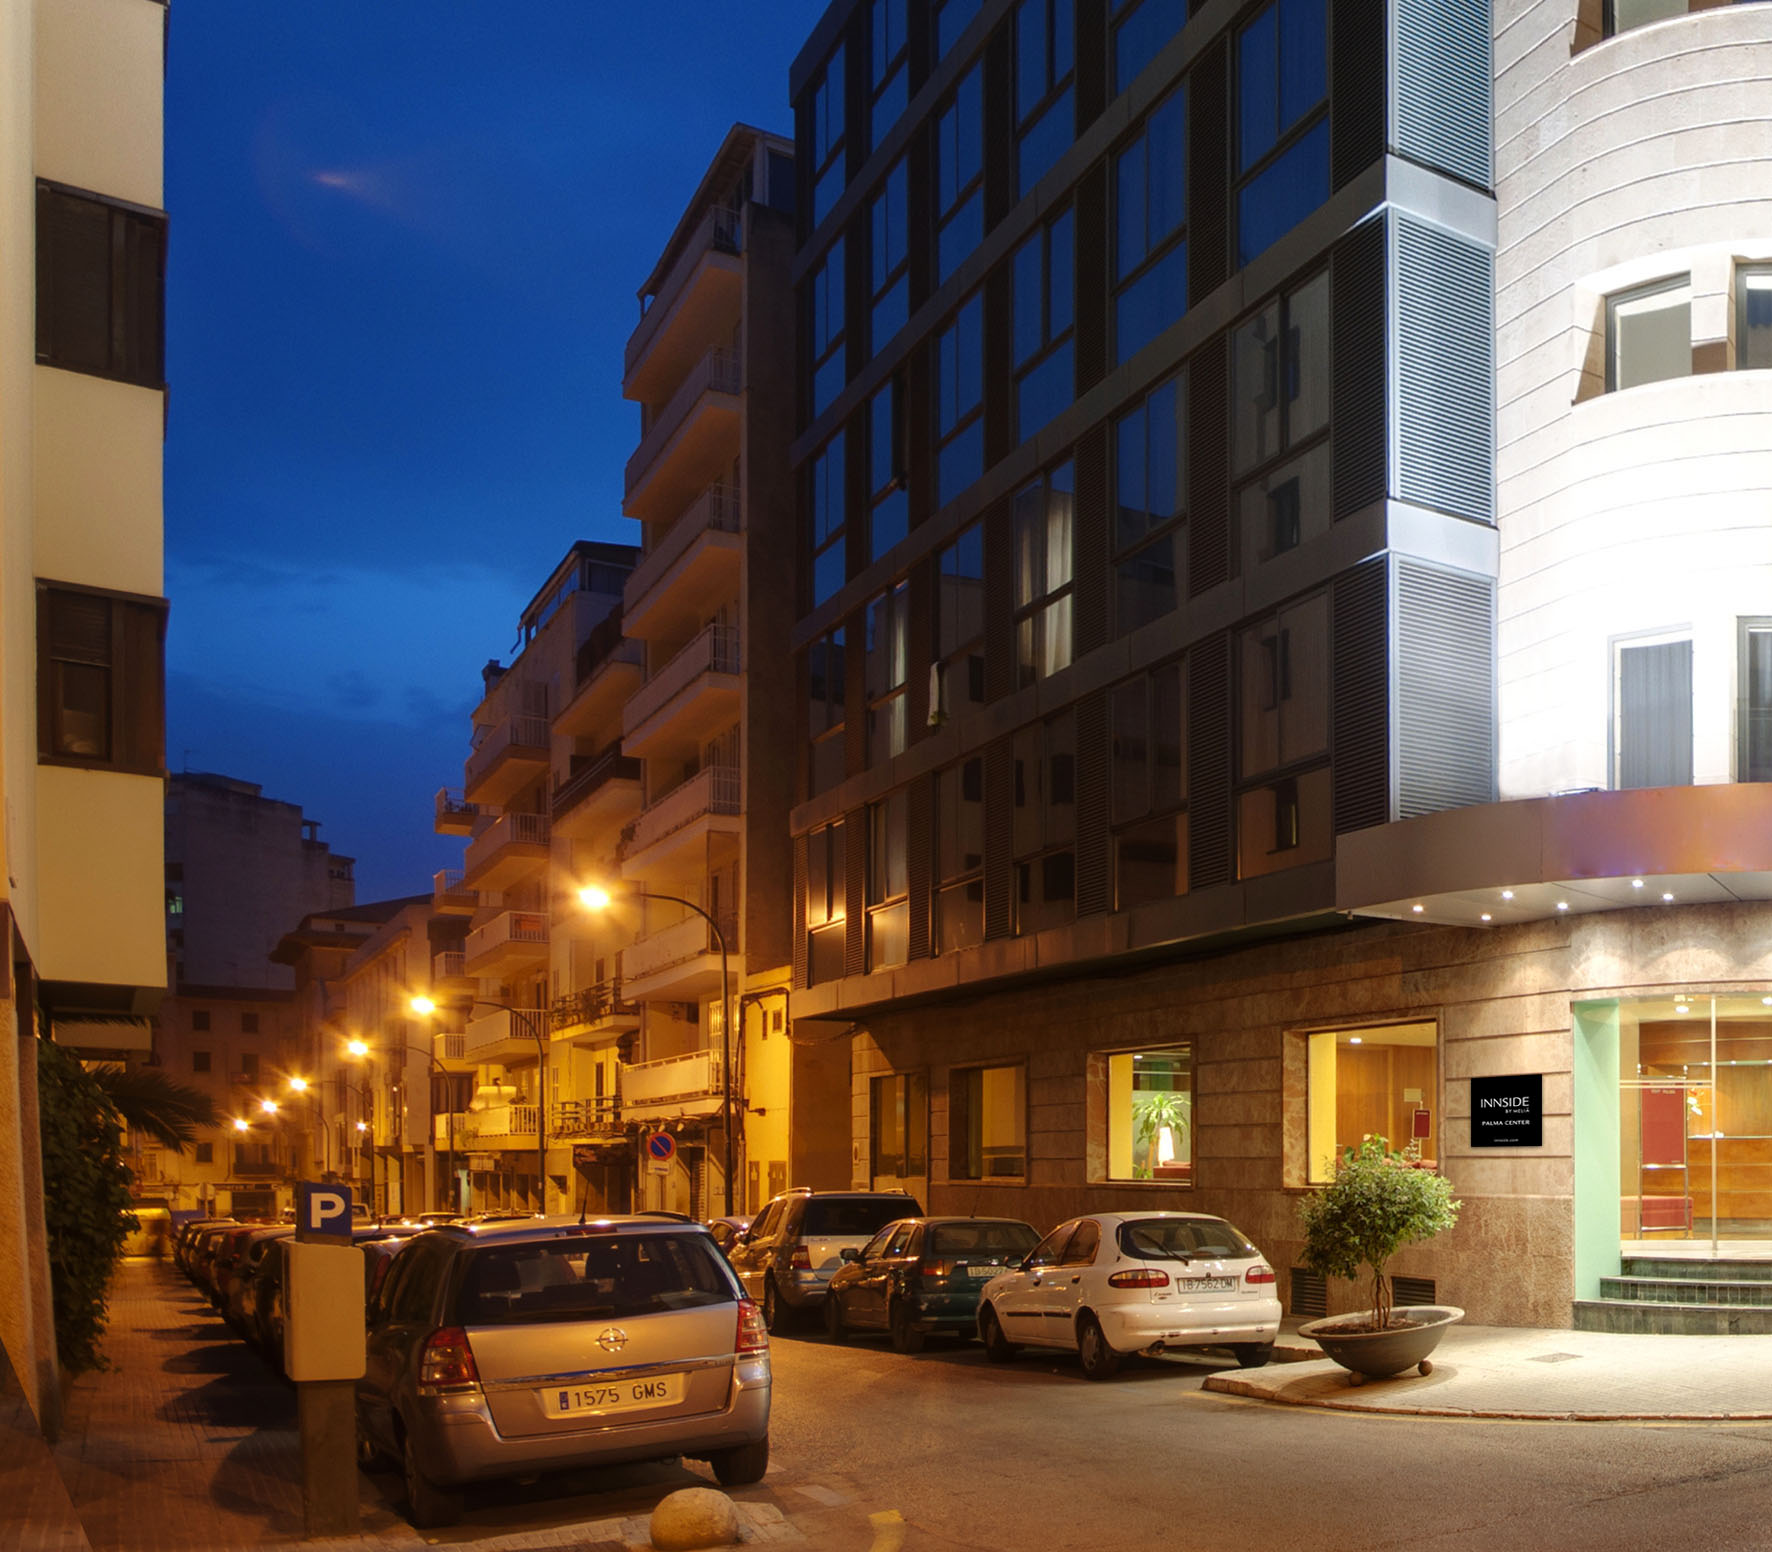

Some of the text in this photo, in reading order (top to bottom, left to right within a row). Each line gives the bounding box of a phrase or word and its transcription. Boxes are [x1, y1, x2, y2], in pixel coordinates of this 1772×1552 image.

[1480, 1096, 1530, 1108] INNSIDE
[311, 1193, 345, 1228] P
[574, 1382, 667, 1407] 1575 GMS
